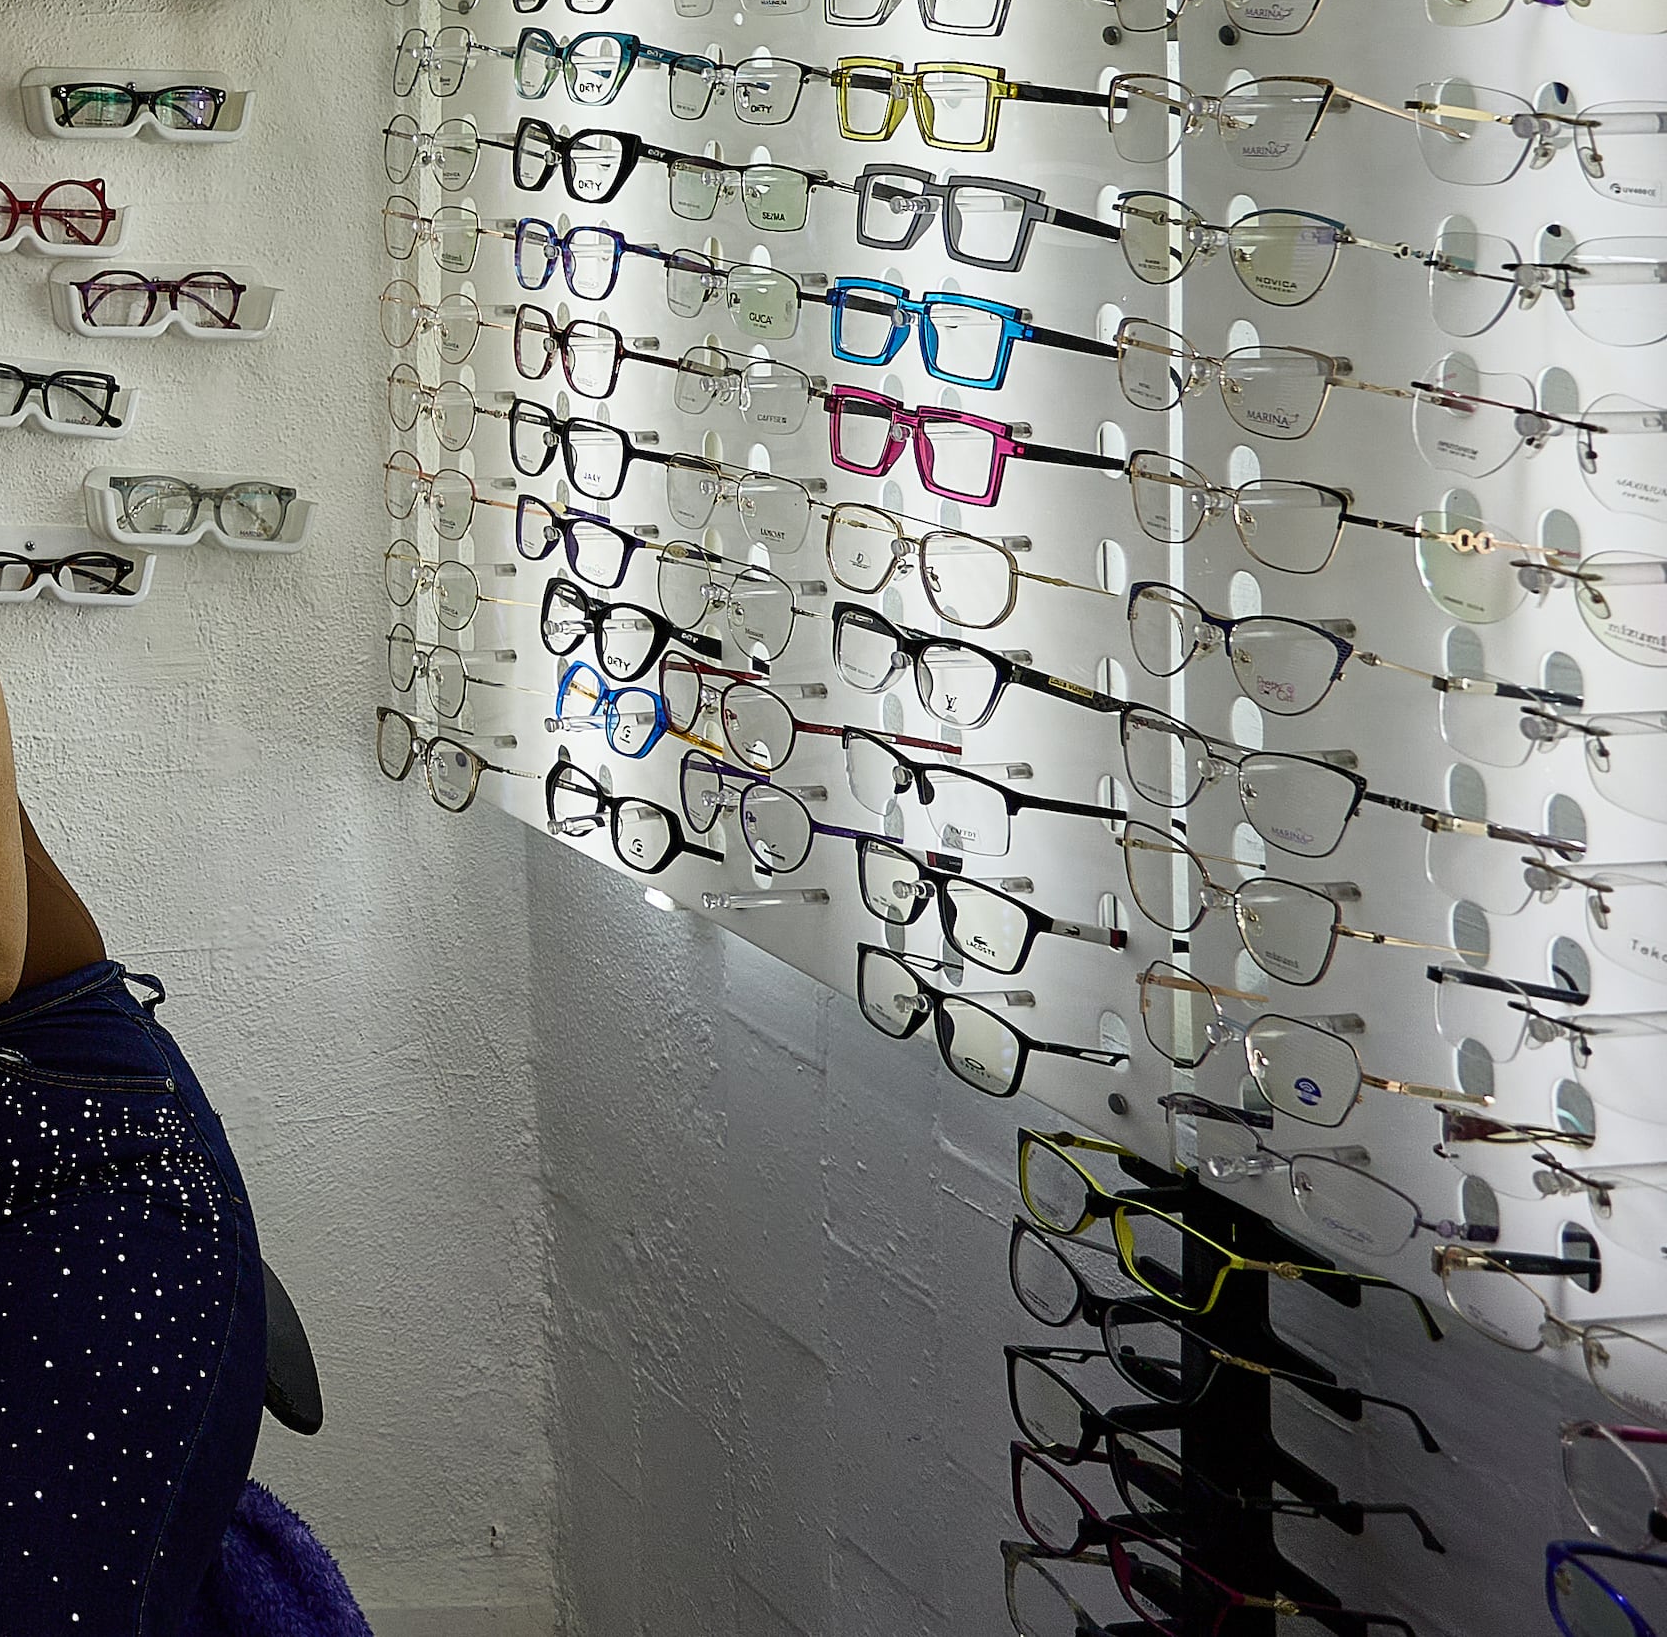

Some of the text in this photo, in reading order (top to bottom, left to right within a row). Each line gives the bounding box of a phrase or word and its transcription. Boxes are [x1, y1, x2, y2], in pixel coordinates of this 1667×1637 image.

[1245, 7, 1284, 20] MARINA
[1242, 146, 1279, 157] MARINA
[1255, 276, 1298, 290] NOVICA
[1246, 408, 1289, 425] MARINA
[965, 939, 997, 958] LACOSTE
